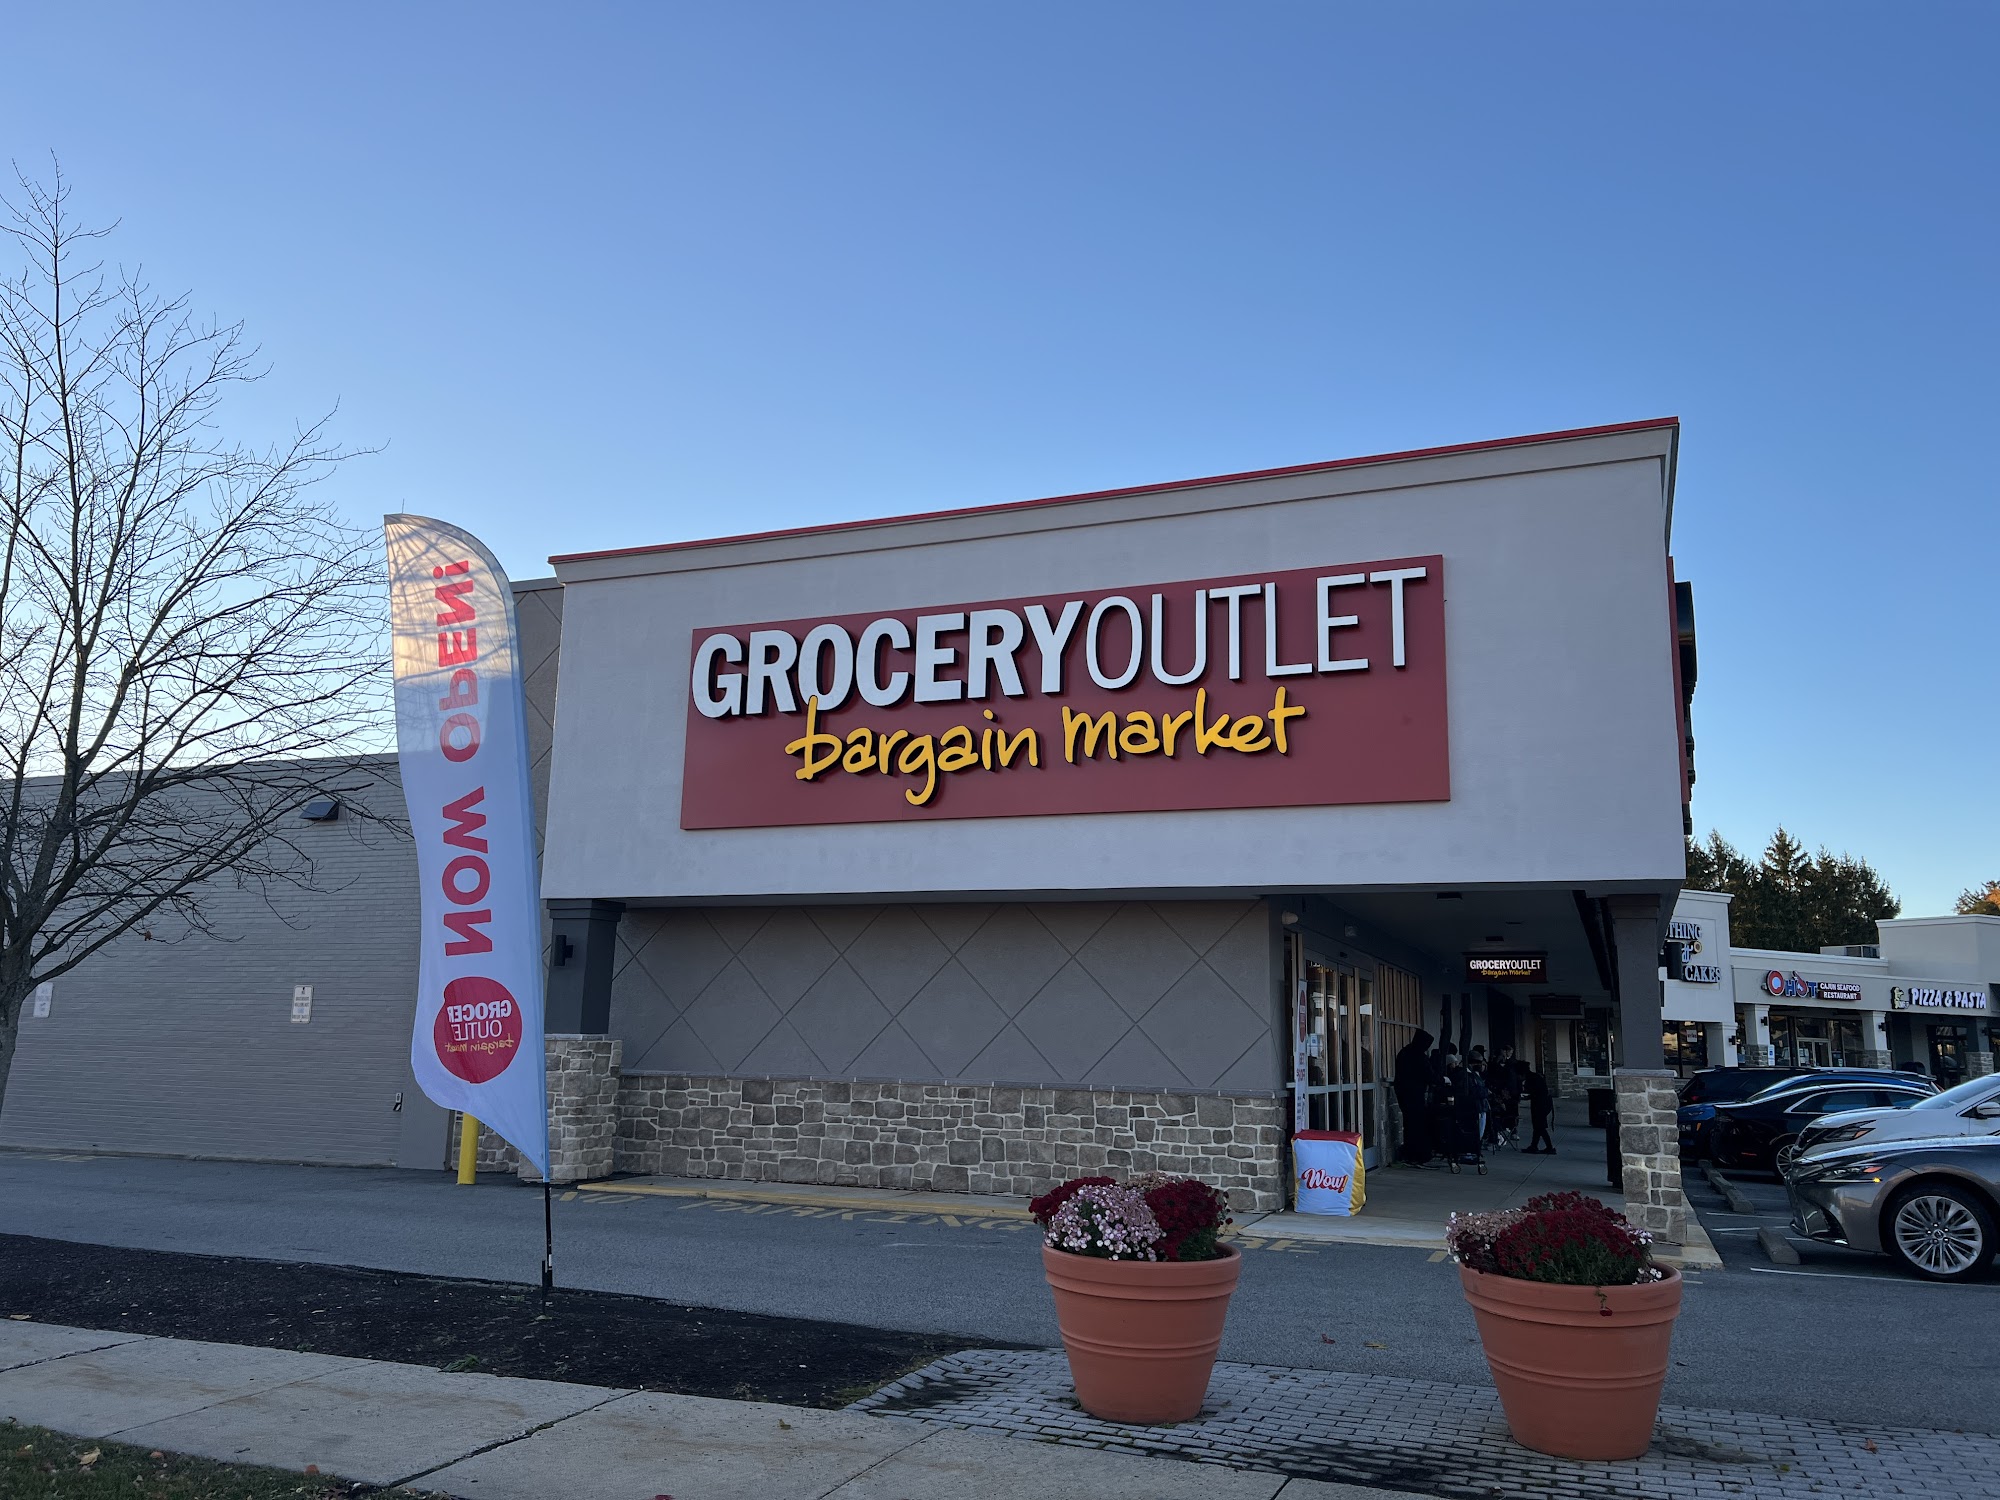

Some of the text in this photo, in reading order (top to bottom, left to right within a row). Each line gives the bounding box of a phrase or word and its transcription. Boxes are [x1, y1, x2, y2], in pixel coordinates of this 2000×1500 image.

[785, 686, 1306, 805] bargain market
[1665, 922, 1702, 939] THING
[1480, 968, 1508, 979] bargain
[1684, 965, 1721, 983] CAKES
[1820, 982, 1860, 992] CAJUN SEAFOOD
[1823, 991, 1858, 1000] RESTAURANT
[1911, 987, 1942, 1007] PIZZA
[1945, 991, 1953, 1008] &
[1955, 991, 1987, 1009] PASTA
[1301, 1168, 1349, 1194] Wow!
[677, 1199, 1037, 1232] PARKING
[1216, 1235, 1333, 1254] RE
